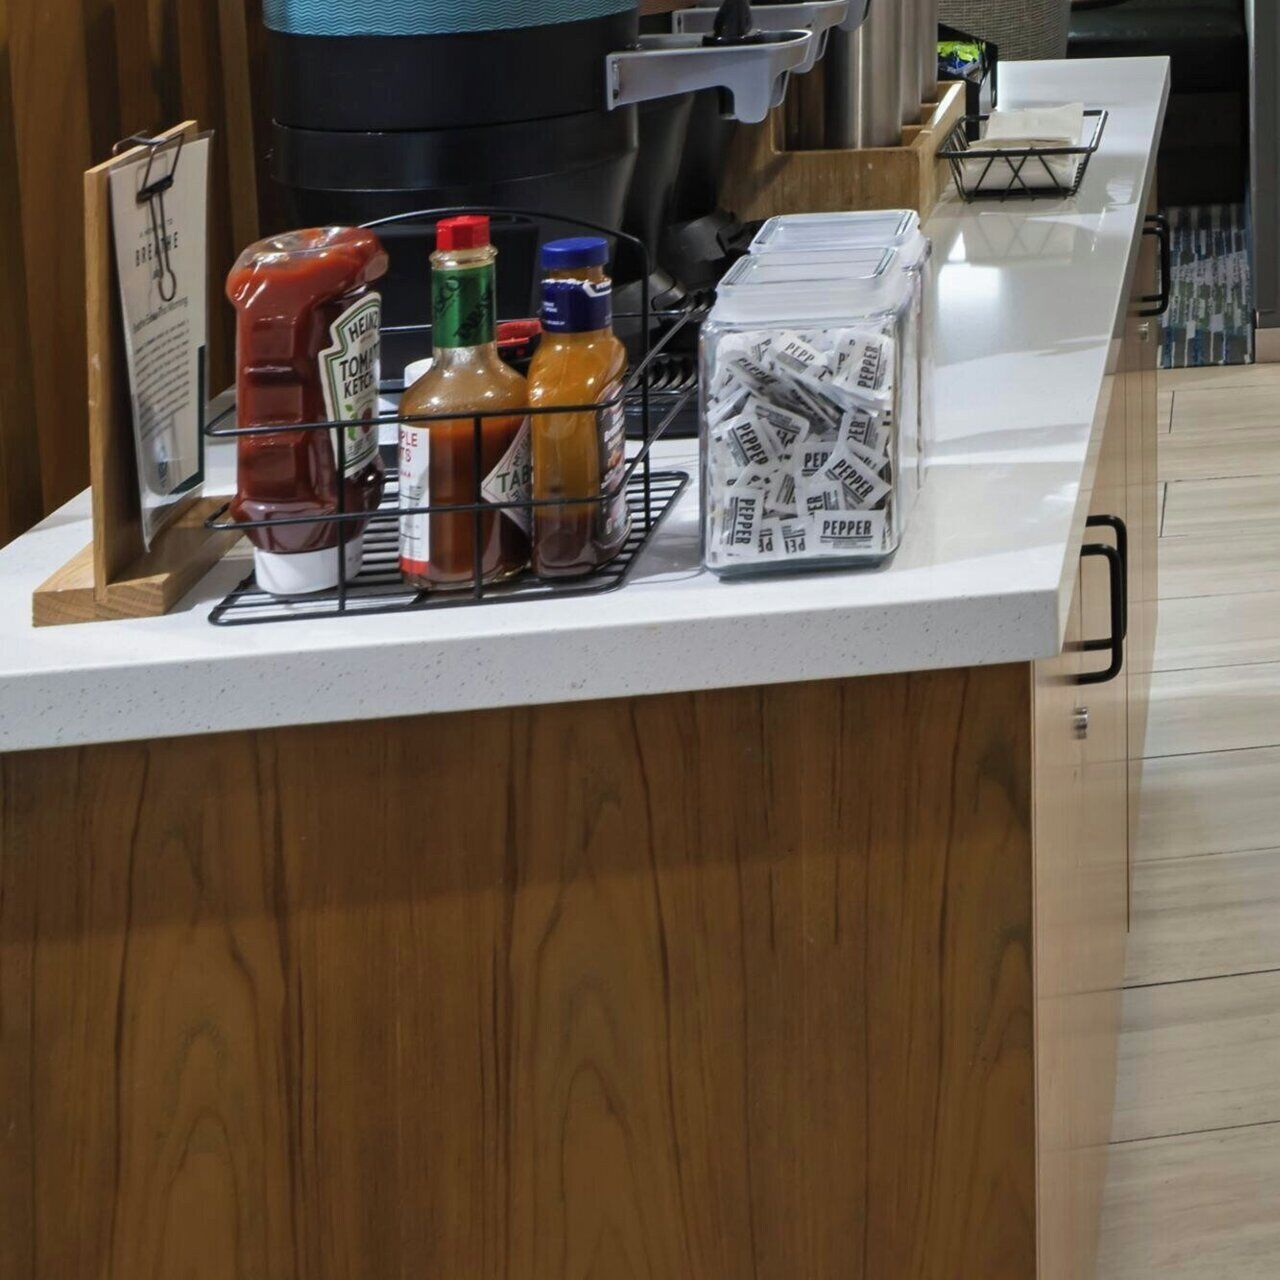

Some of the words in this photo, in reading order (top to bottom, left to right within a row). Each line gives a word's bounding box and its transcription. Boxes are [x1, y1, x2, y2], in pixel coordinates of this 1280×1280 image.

[784, 342, 816, 363] PEPP
[857, 345, 879, 389] PEPPER
[736, 422, 769, 466] PEPPER
[833, 458, 874, 499] PEPPER
[735, 499, 756, 544] PEPPER
[822, 519, 872, 536] PEPPER
